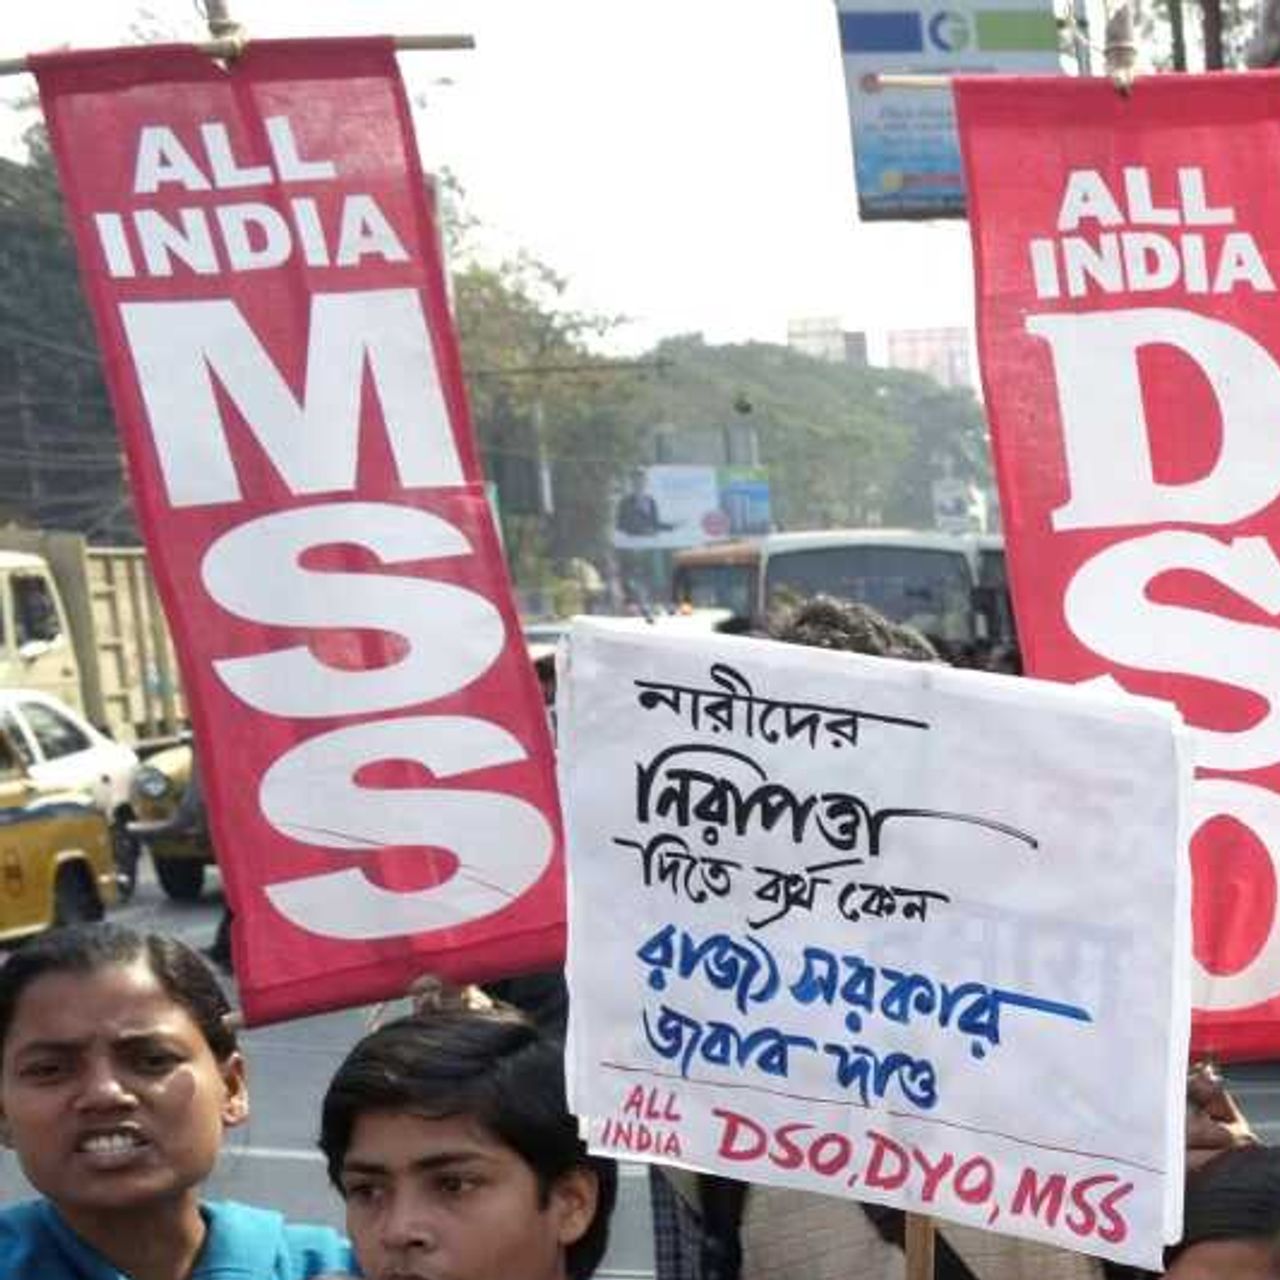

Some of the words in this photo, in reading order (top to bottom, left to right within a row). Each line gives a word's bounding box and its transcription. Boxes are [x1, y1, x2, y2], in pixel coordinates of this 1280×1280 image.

[134, 115, 334, 193] ALL
[94, 196, 409, 278] INDIA
[1057, 167, 1236, 230] ALL
[1029, 232, 1277, 299] INDIA
[635, 663, 930, 749] নারীদের
[635, 743, 1038, 857] নিরাপত্তা
[613, 834, 742, 904] দিতে
[838, 880, 951, 923] কেন
[636, 924, 779, 1015] রাজ্য
[789, 948, 1092, 1061] সরকার
[642, 1004, 818, 1080] জবাব
[822, 1041, 940, 1110] দাও
[601, 1118, 683, 1156] INDIA
[624, 1083, 682, 1122] ALL
